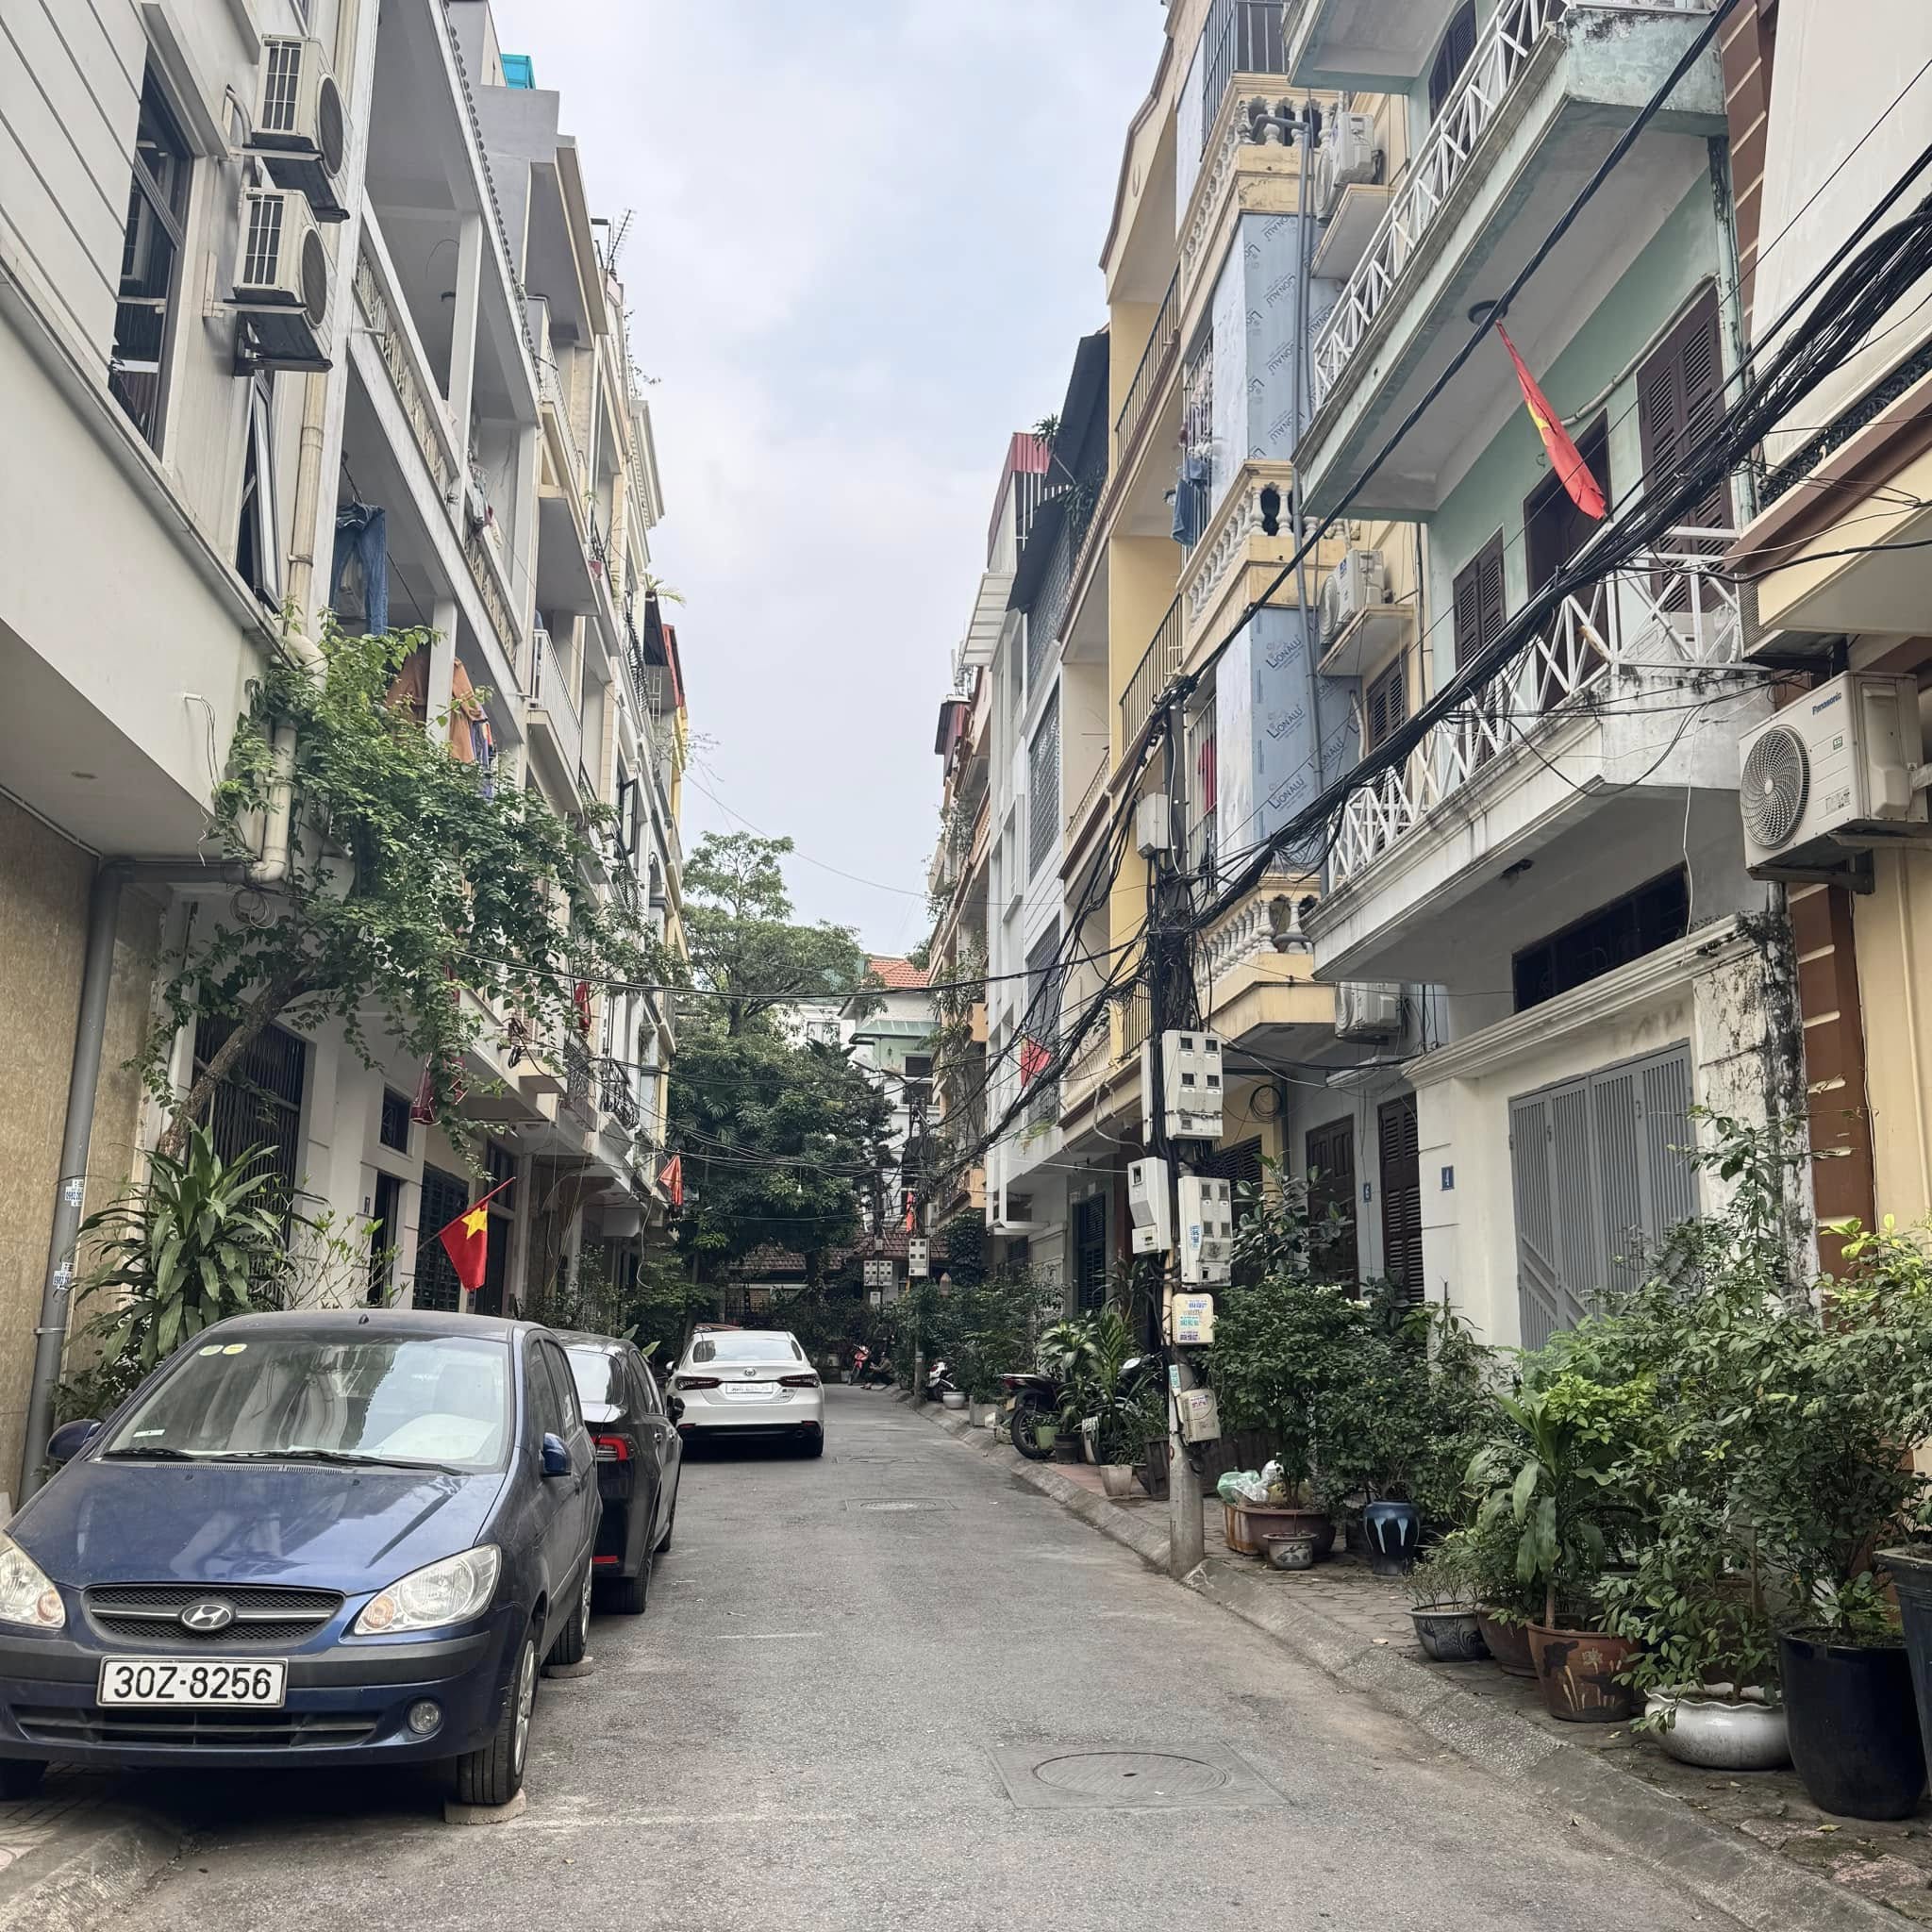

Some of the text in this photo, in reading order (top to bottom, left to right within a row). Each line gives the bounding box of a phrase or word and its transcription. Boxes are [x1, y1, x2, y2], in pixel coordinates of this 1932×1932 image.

[1265, 637, 1302, 669] LIONALU
[1812, 692, 1841, 715] Panasonic
[1266, 707, 1304, 739] LIONALU
[1267, 777, 1306, 809] LIONALU
[113, 1666, 272, 1700] 30Z-8256
